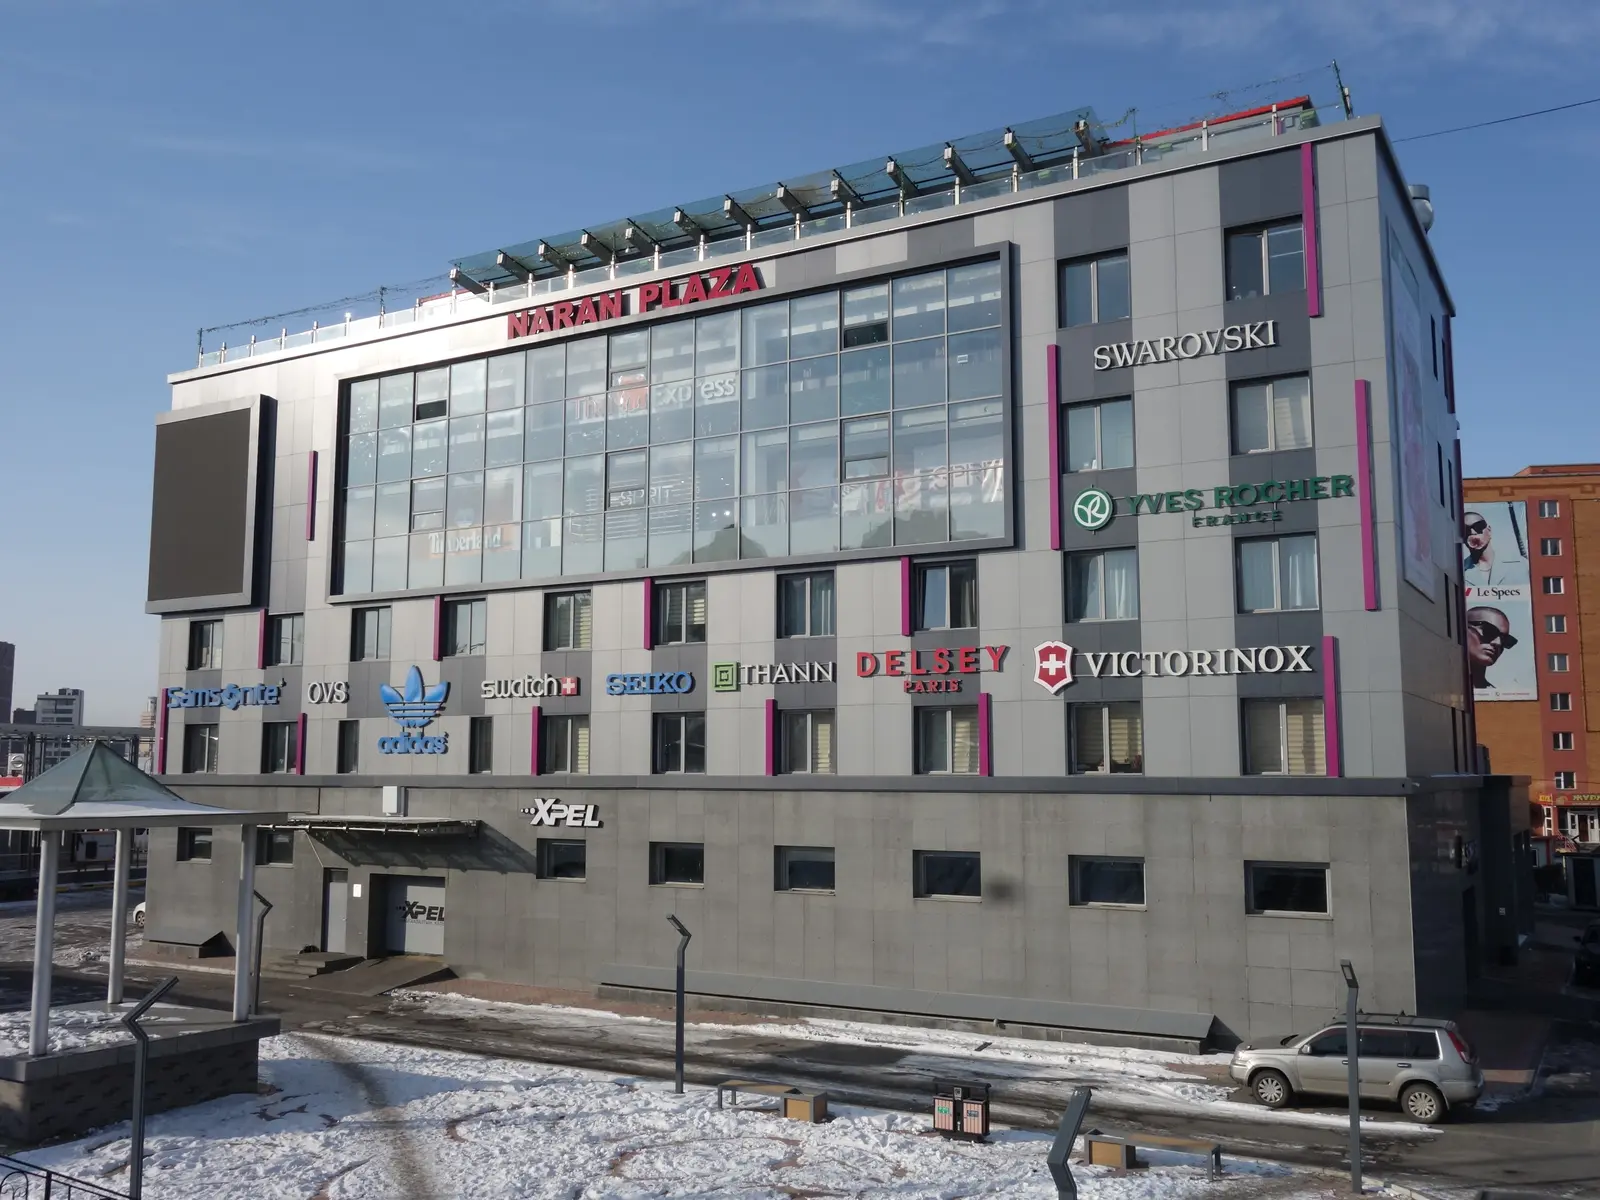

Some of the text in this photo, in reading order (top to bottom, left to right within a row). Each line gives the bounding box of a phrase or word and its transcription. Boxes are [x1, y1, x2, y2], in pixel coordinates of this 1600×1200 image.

[507, 263, 762, 339] NARAN PLAZA
[1093, 320, 1277, 371] SWAROVSKI
[1125, 475, 1355, 516] YVES ROCHER
[1192, 510, 1282, 528] FRANCE
[1477, 588, 1520, 600] Le Specs
[740, 662, 836, 685] THANN
[856, 645, 1009, 677] DELSEY
[1086, 645, 1314, 678] VICTORINOX
[308, 680, 349, 704] OVS
[480, 673, 559, 699] swatch
[606, 672, 694, 694] SEIKO
[904, 679, 963, 693] PARIS
[167, 683, 281, 710] Samsonite
[378, 732, 448, 754] adidas
[529, 797, 603, 828] XPEL
